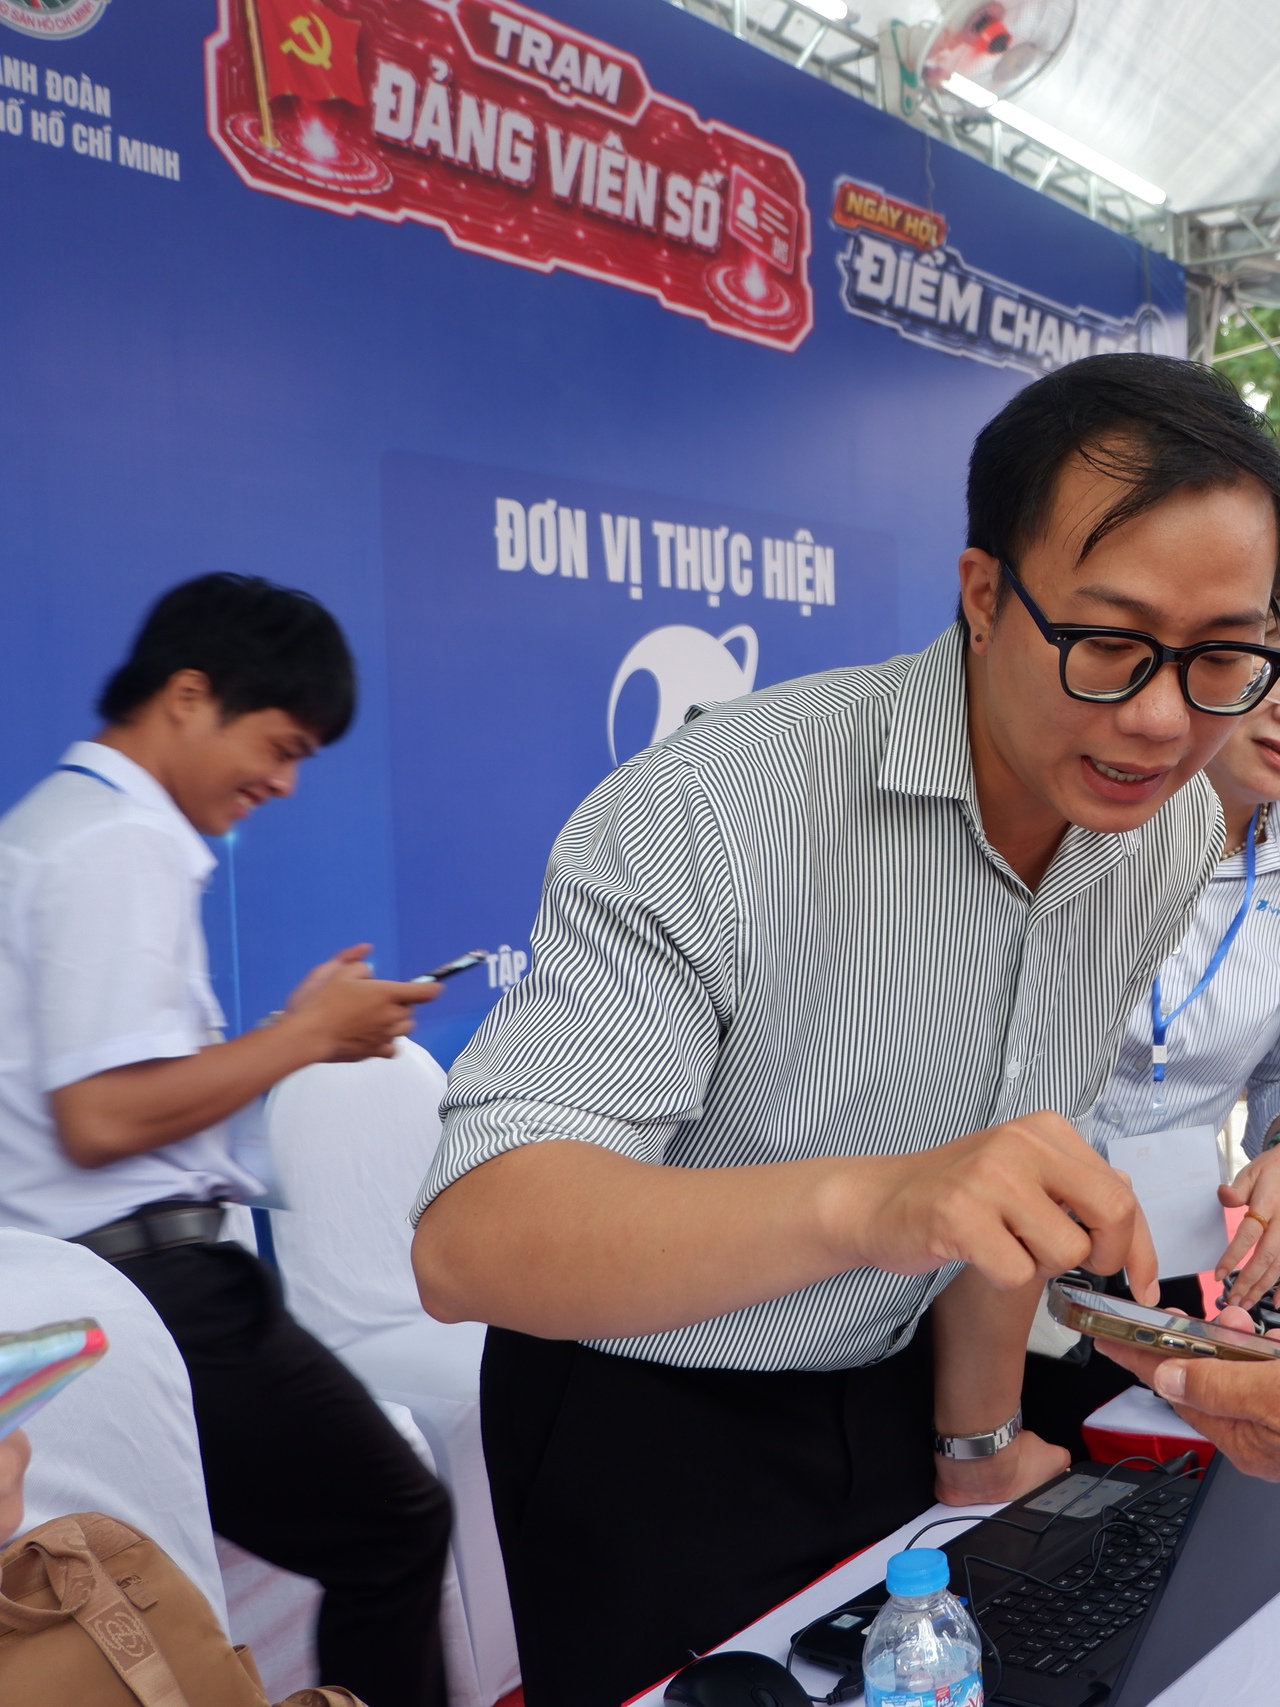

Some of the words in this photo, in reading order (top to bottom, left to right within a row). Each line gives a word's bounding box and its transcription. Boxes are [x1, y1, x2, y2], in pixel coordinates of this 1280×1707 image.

[45, 67, 111, 119] ĐOÀN
[490, 10, 622, 104] TRẠM
[30, 108, 66, 149] HỒ
[72, 121, 112, 162] CHÍ
[118, 134, 180, 182] MINH
[372, 56, 536, 184] ĐẢNG
[546, 130, 660, 228] VIÊN
[663, 169, 726, 248] SỐ
[845, 190, 903, 231] NGÀY
[989, 296, 1092, 369] CHẠM
[494, 497, 589, 579] ĐƠN
[600, 512, 643, 600] VỊ
[650, 519, 753, 608] THỰC
[761, 528, 836, 617] HIỆN
[485, 944, 528, 994] TẬP
